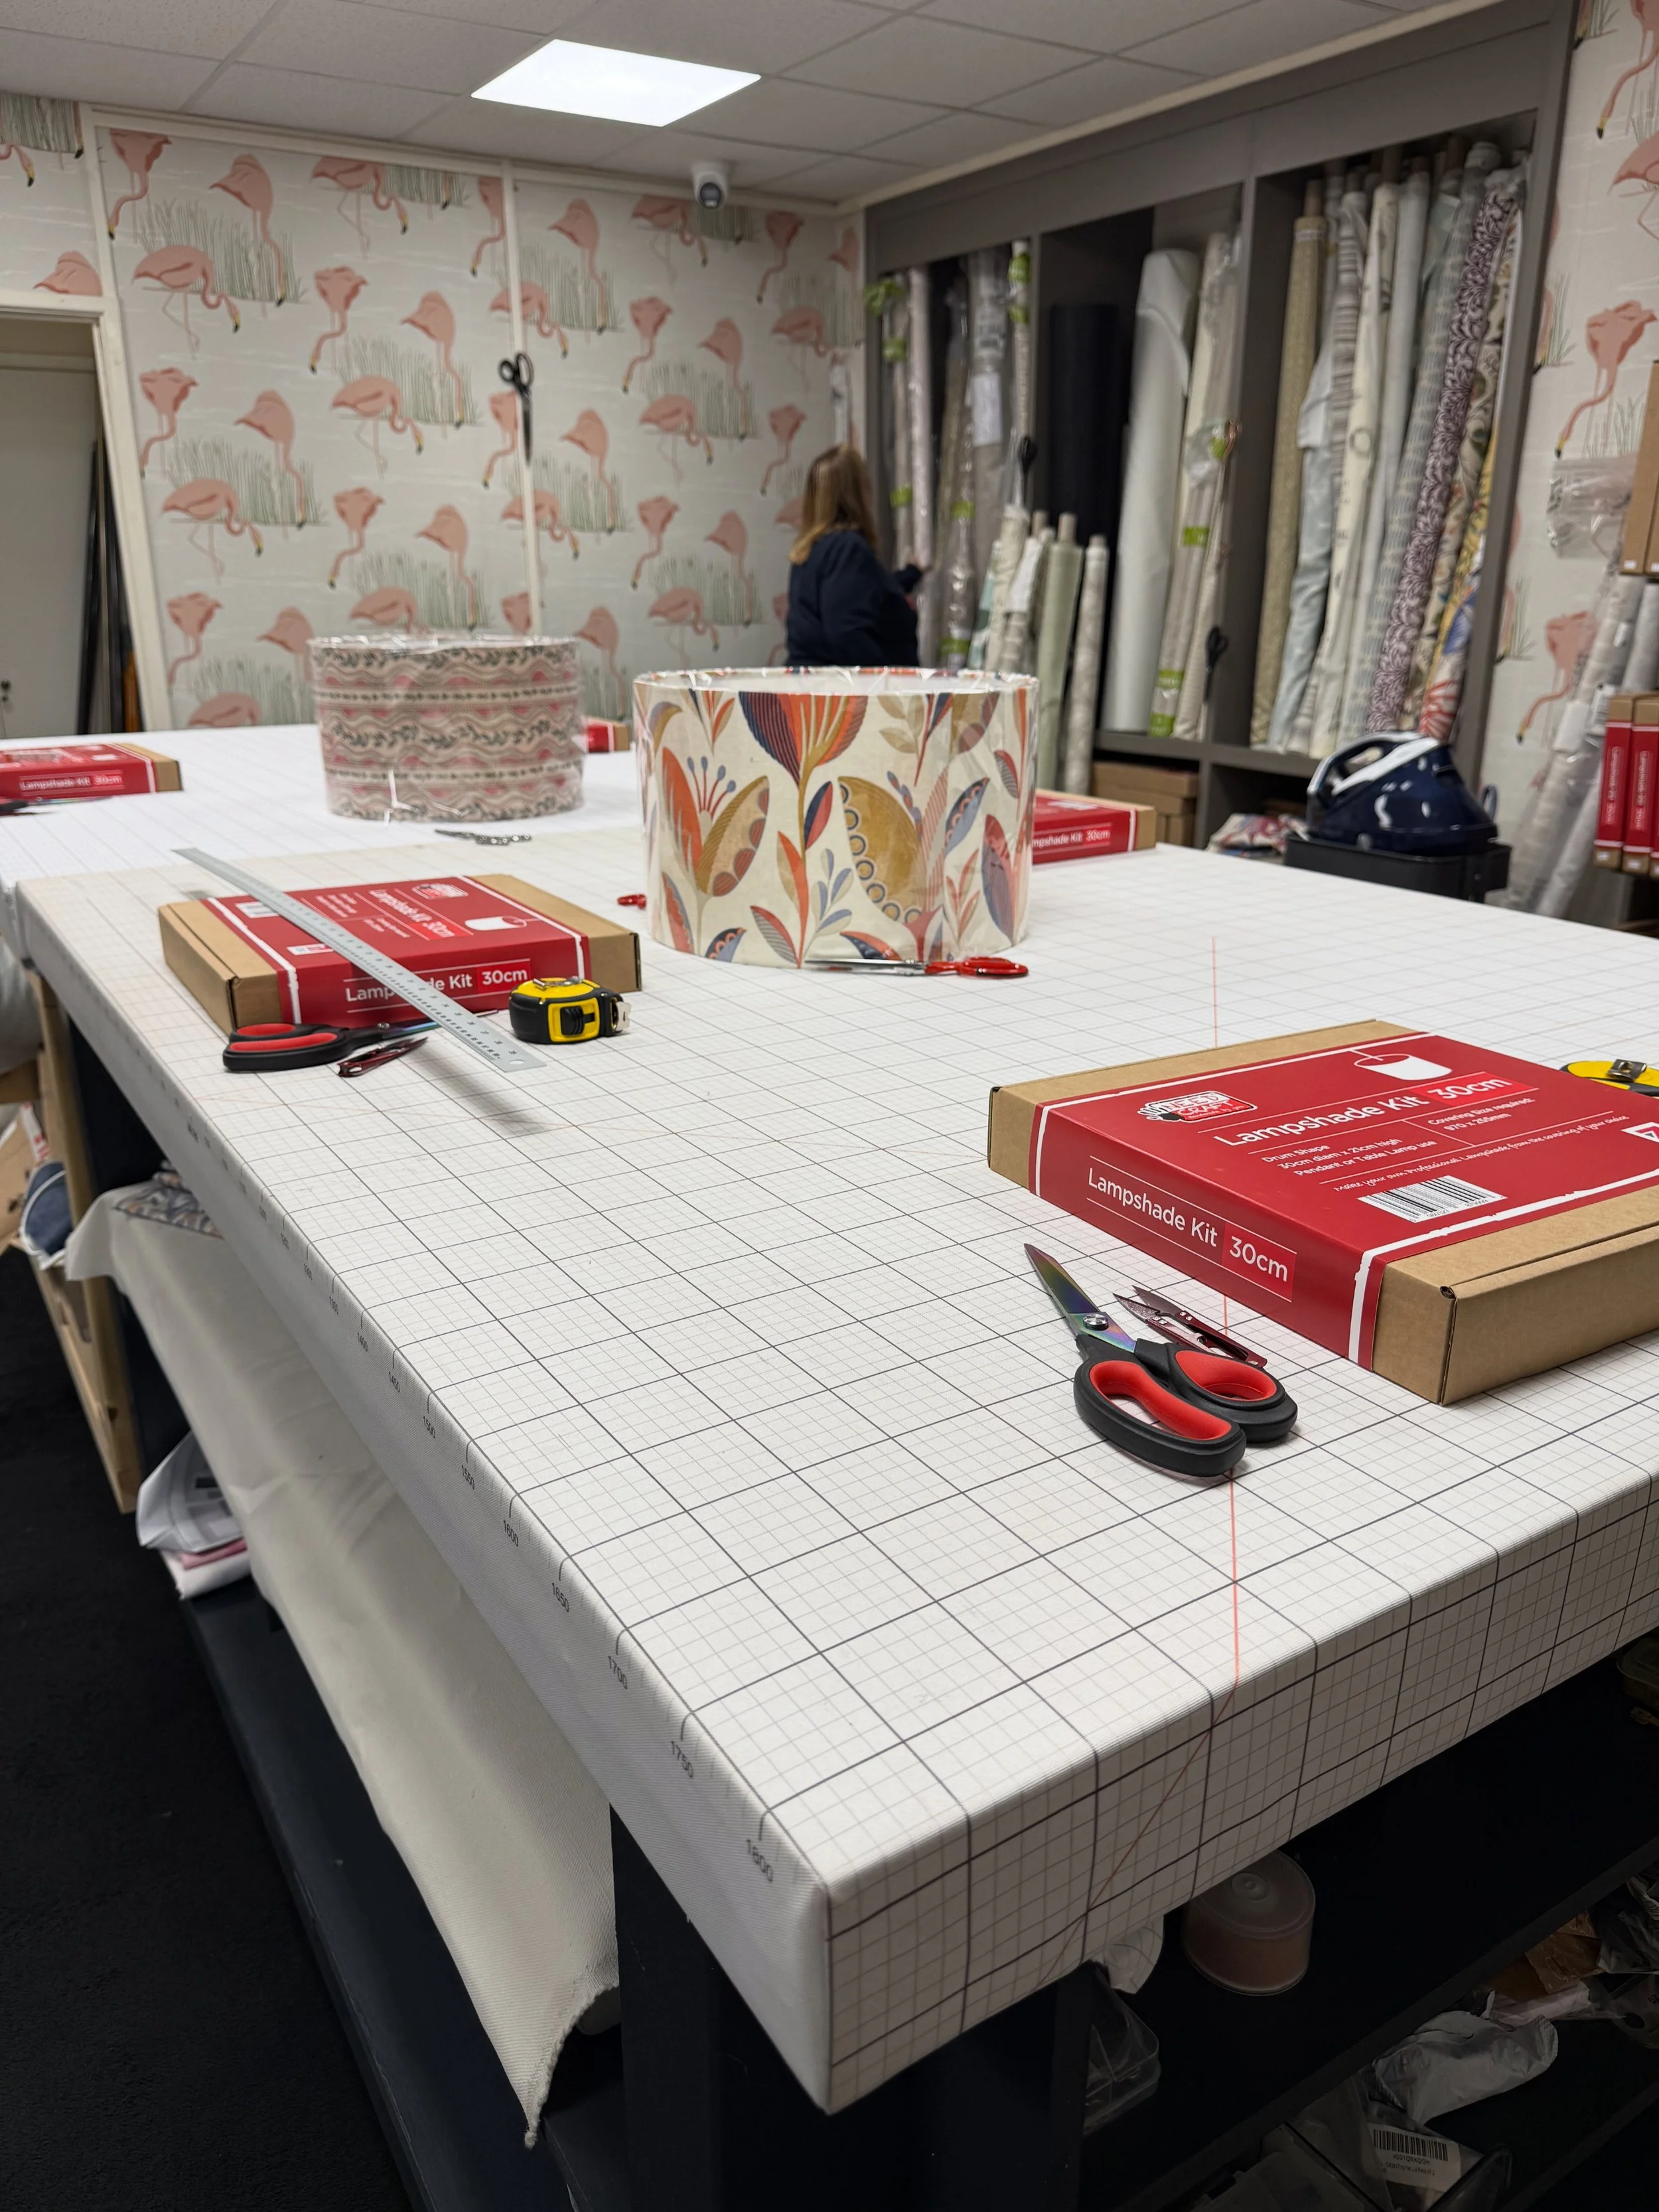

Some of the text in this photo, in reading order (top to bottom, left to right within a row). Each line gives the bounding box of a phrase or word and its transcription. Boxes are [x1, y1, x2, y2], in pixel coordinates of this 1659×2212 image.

[346, 969, 528, 1003] Lampde Kit 30cm
[1166, 1096, 1220, 1111] NEED
[1178, 1101, 1233, 1116] CRAFT
[1213, 1077, 1512, 1146] Lampshade Kit 30cm
[1428, 1112, 1475, 1125] Covering
[1262, 1144, 1331, 1163] Drum Shape
[1277, 1158, 1313, 1169] 30cm
[1313, 1151, 1340, 1163] diam
[1348, 1143, 1374, 1154] 21cm
[1376, 1138, 1402, 1149] high
[1293, 1161, 1344, 1176] Pendant
[1354, 1150, 1388, 1161] Table
[1386, 1145, 1417, 1157] Lamp
[1088, 1167, 1287, 1282] Lampshade Kit 30cm
[357, 1332, 368, 1352] 1400
[388, 1371, 400, 1393] 1450
[423, 1416, 435, 1439] 1500
[461, 1465, 474, 1490] 1550
[503, 1520, 519, 1547] 1600
[551, 1582, 569, 1613] 1650
[608, 1655, 628, 1690] 1700
[671, 1741, 694, 1779] 1750
[747, 1839, 774, 1883] 1800
